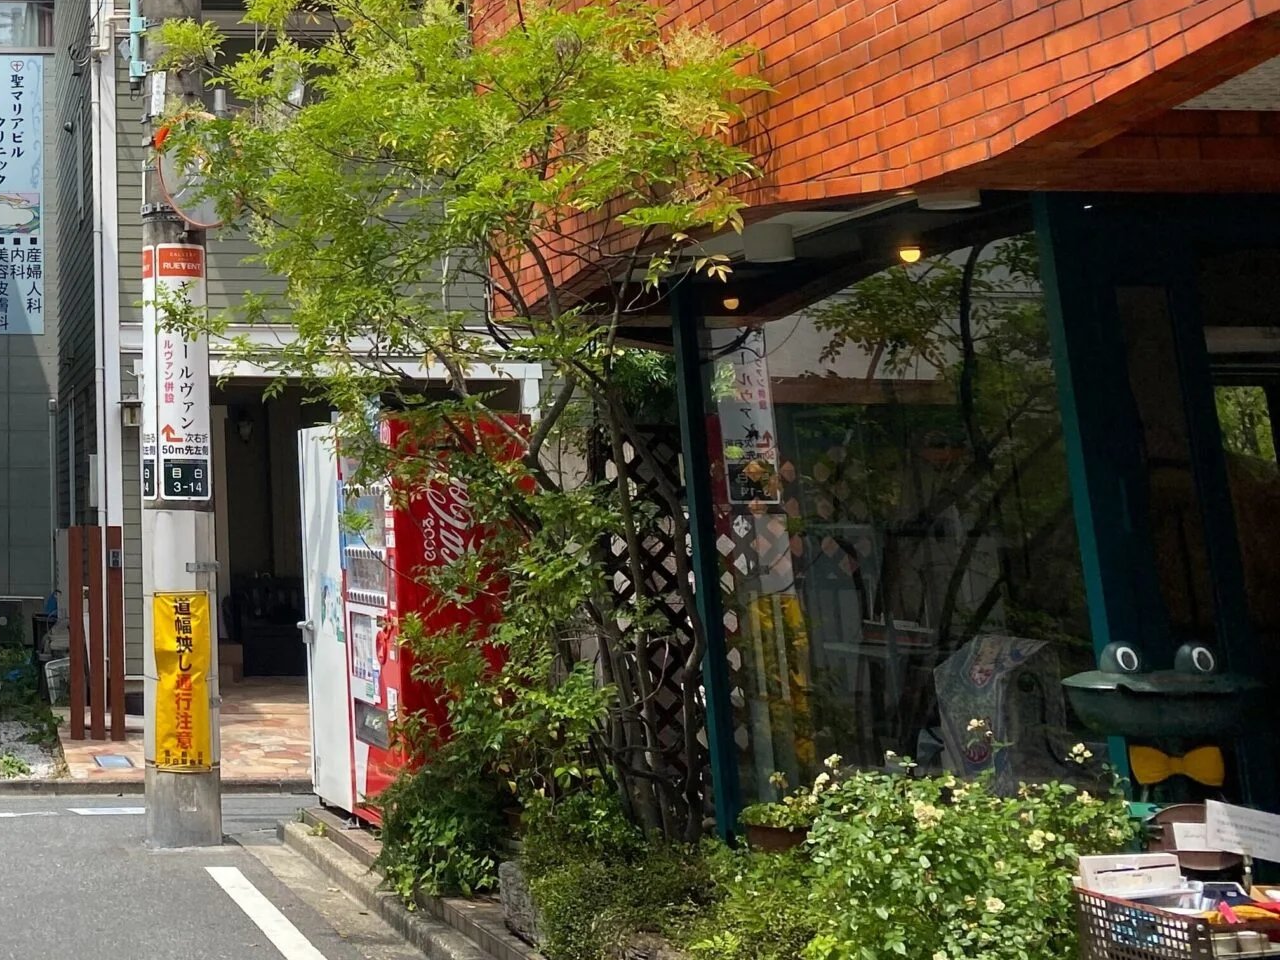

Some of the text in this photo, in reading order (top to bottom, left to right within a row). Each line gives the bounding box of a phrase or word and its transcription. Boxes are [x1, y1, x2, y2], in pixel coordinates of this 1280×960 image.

[10, 247, 25, 280] 内科
[26, 247, 42, 314] 産婦人科
[173, 481, 202, 493] 3-14
[174, 597, 193, 749] 道幅狭し通行注意
